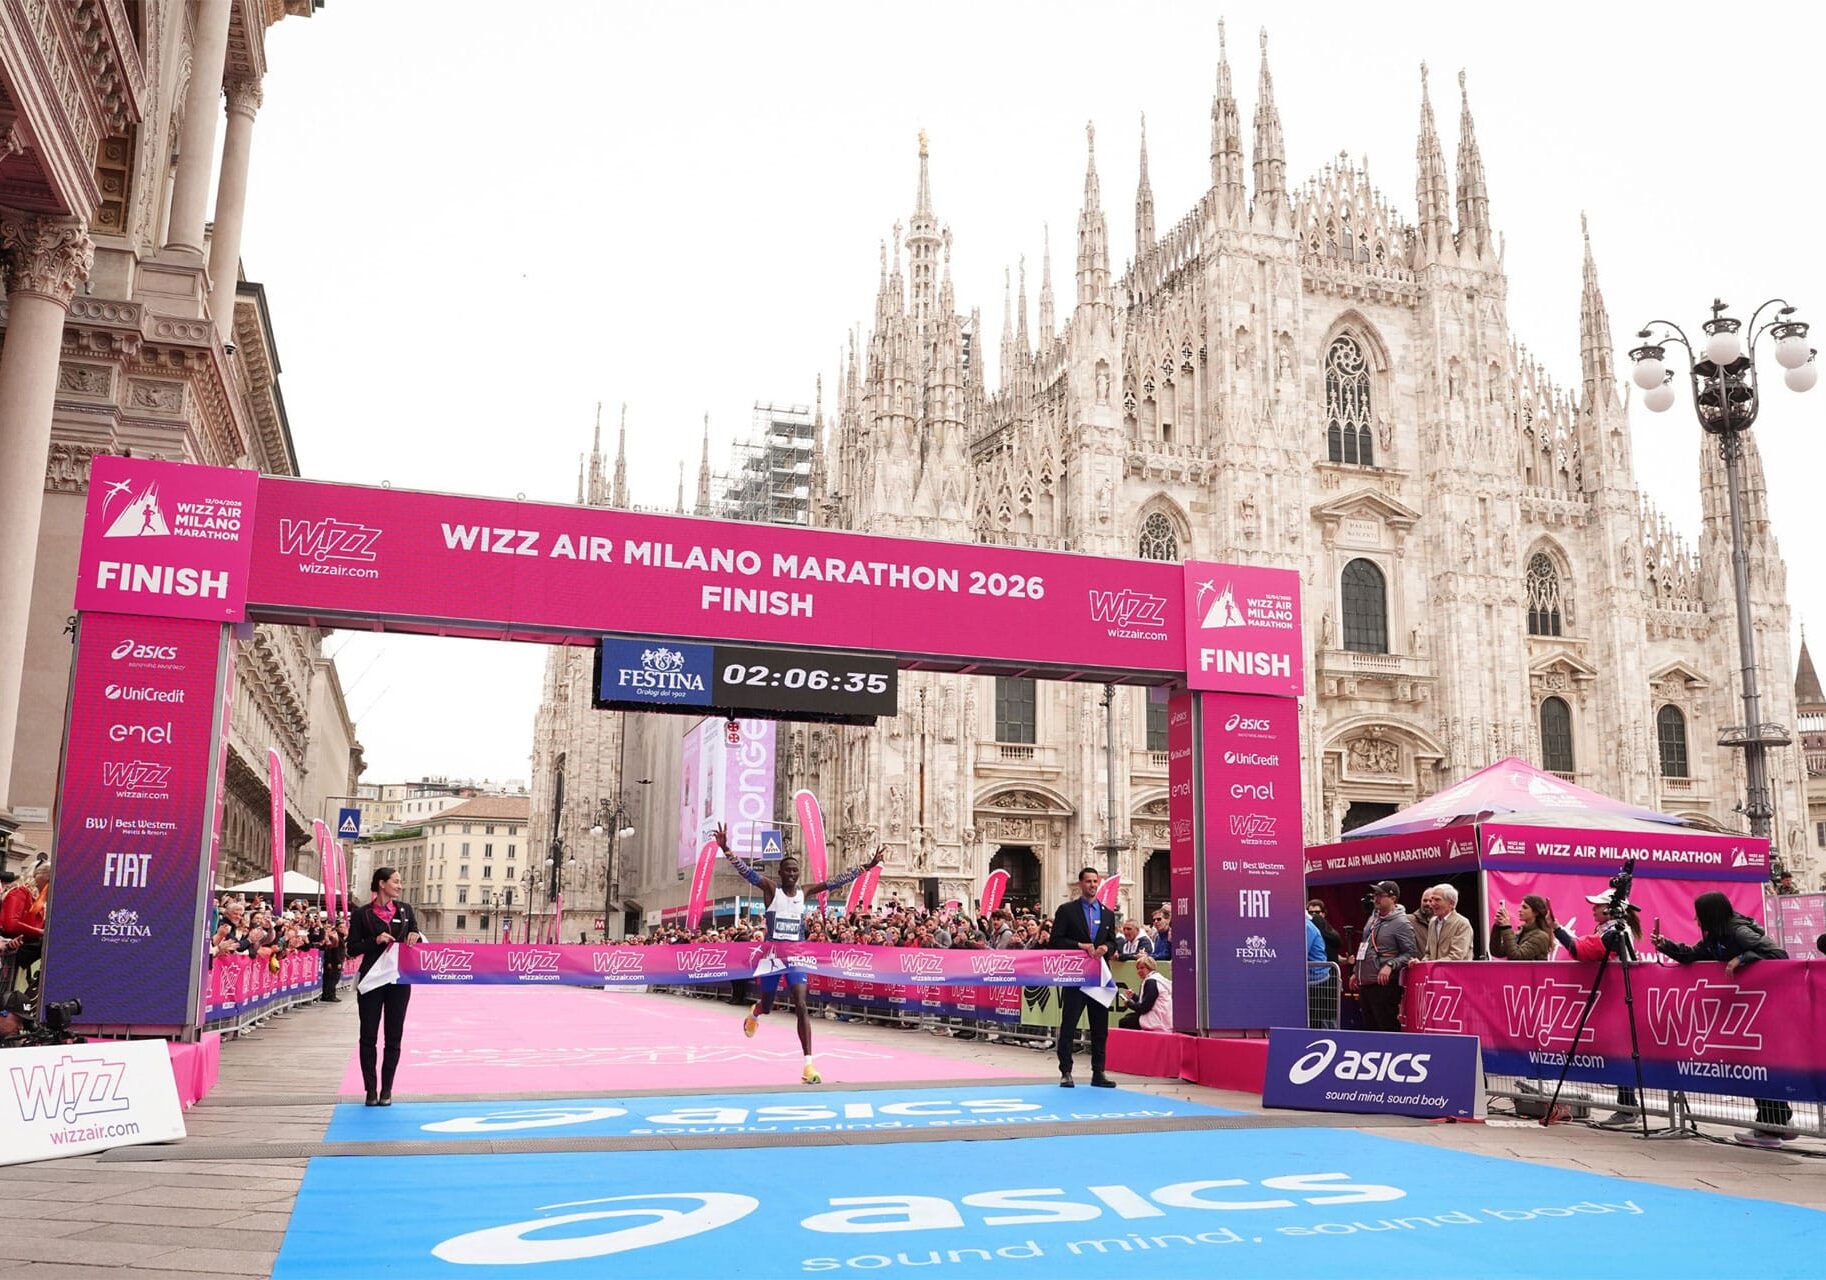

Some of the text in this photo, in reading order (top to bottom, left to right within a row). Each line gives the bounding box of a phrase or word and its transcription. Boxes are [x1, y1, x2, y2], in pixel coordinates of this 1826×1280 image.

[176, 503, 242, 518] WIZZ AIR
[175, 515, 241, 531] MILANO
[173, 528, 239, 542] MARATHON
[298, 562, 380, 579] wizzair.com
[440, 523, 1045, 601] WIZZ AIR MILANO MARATHON 2026
[96, 560, 229, 599] FINISH
[701, 585, 814, 618] FINISH
[1246, 598, 1292, 610] WIZZ AIR
[1247, 608, 1293, 621] MILANO
[1248, 619, 1293, 630] MARATHON
[1107, 627, 1169, 641] wizzair.com
[1200, 648, 1292, 678] FINISH
[618, 668, 705, 691] FESTINA
[722, 664, 889, 694] 02:06:35
[122, 686, 185, 703] UniCredit
[109, 722, 172, 744] enel
[1235, 753, 1280, 767] UniCredit
[115, 790, 169, 800] wizzair.com
[1171, 779, 1191, 798] enel
[1230, 781, 1275, 800] enel
[85, 817, 108, 830] BW
[115, 818, 137, 829] Best
[1240, 837, 1278, 846] wizzair.com
[1327, 857, 1347, 869] WIZZ
[1347, 856, 1361, 868] AIR
[1361, 852, 1392, 866] MILANO
[1393, 846, 1442, 862] MARATHON
[1536, 843, 1722, 864] WIZZ AIR MILANO MARATHON
[103, 853, 152, 888] FIAT
[1222, 860, 1238, 871] BW
[1177, 897, 1189, 916] FIAT
[1239, 889, 1271, 918] FIAT
[91, 924, 152, 937] FESTINA
[1235, 948, 1277, 959] FESTINA
[431, 973, 474, 981] wizzair.com
[518, 973, 561, 981] wizzair.com
[603, 973, 645, 981] wizzair.com
[688, 971, 728, 979] wizzair.com
[1676, 1058, 1768, 1081] wizzair.com
[1325, 1090, 1449, 1110] sound mind, sound body
[928, 1113, 1061, 1127] sound
[1070, 1109, 1174, 1120] body
[50, 1122, 140, 1145] wizzair.com
[801, 1200, 1645, 1272] sound mind, sound body
